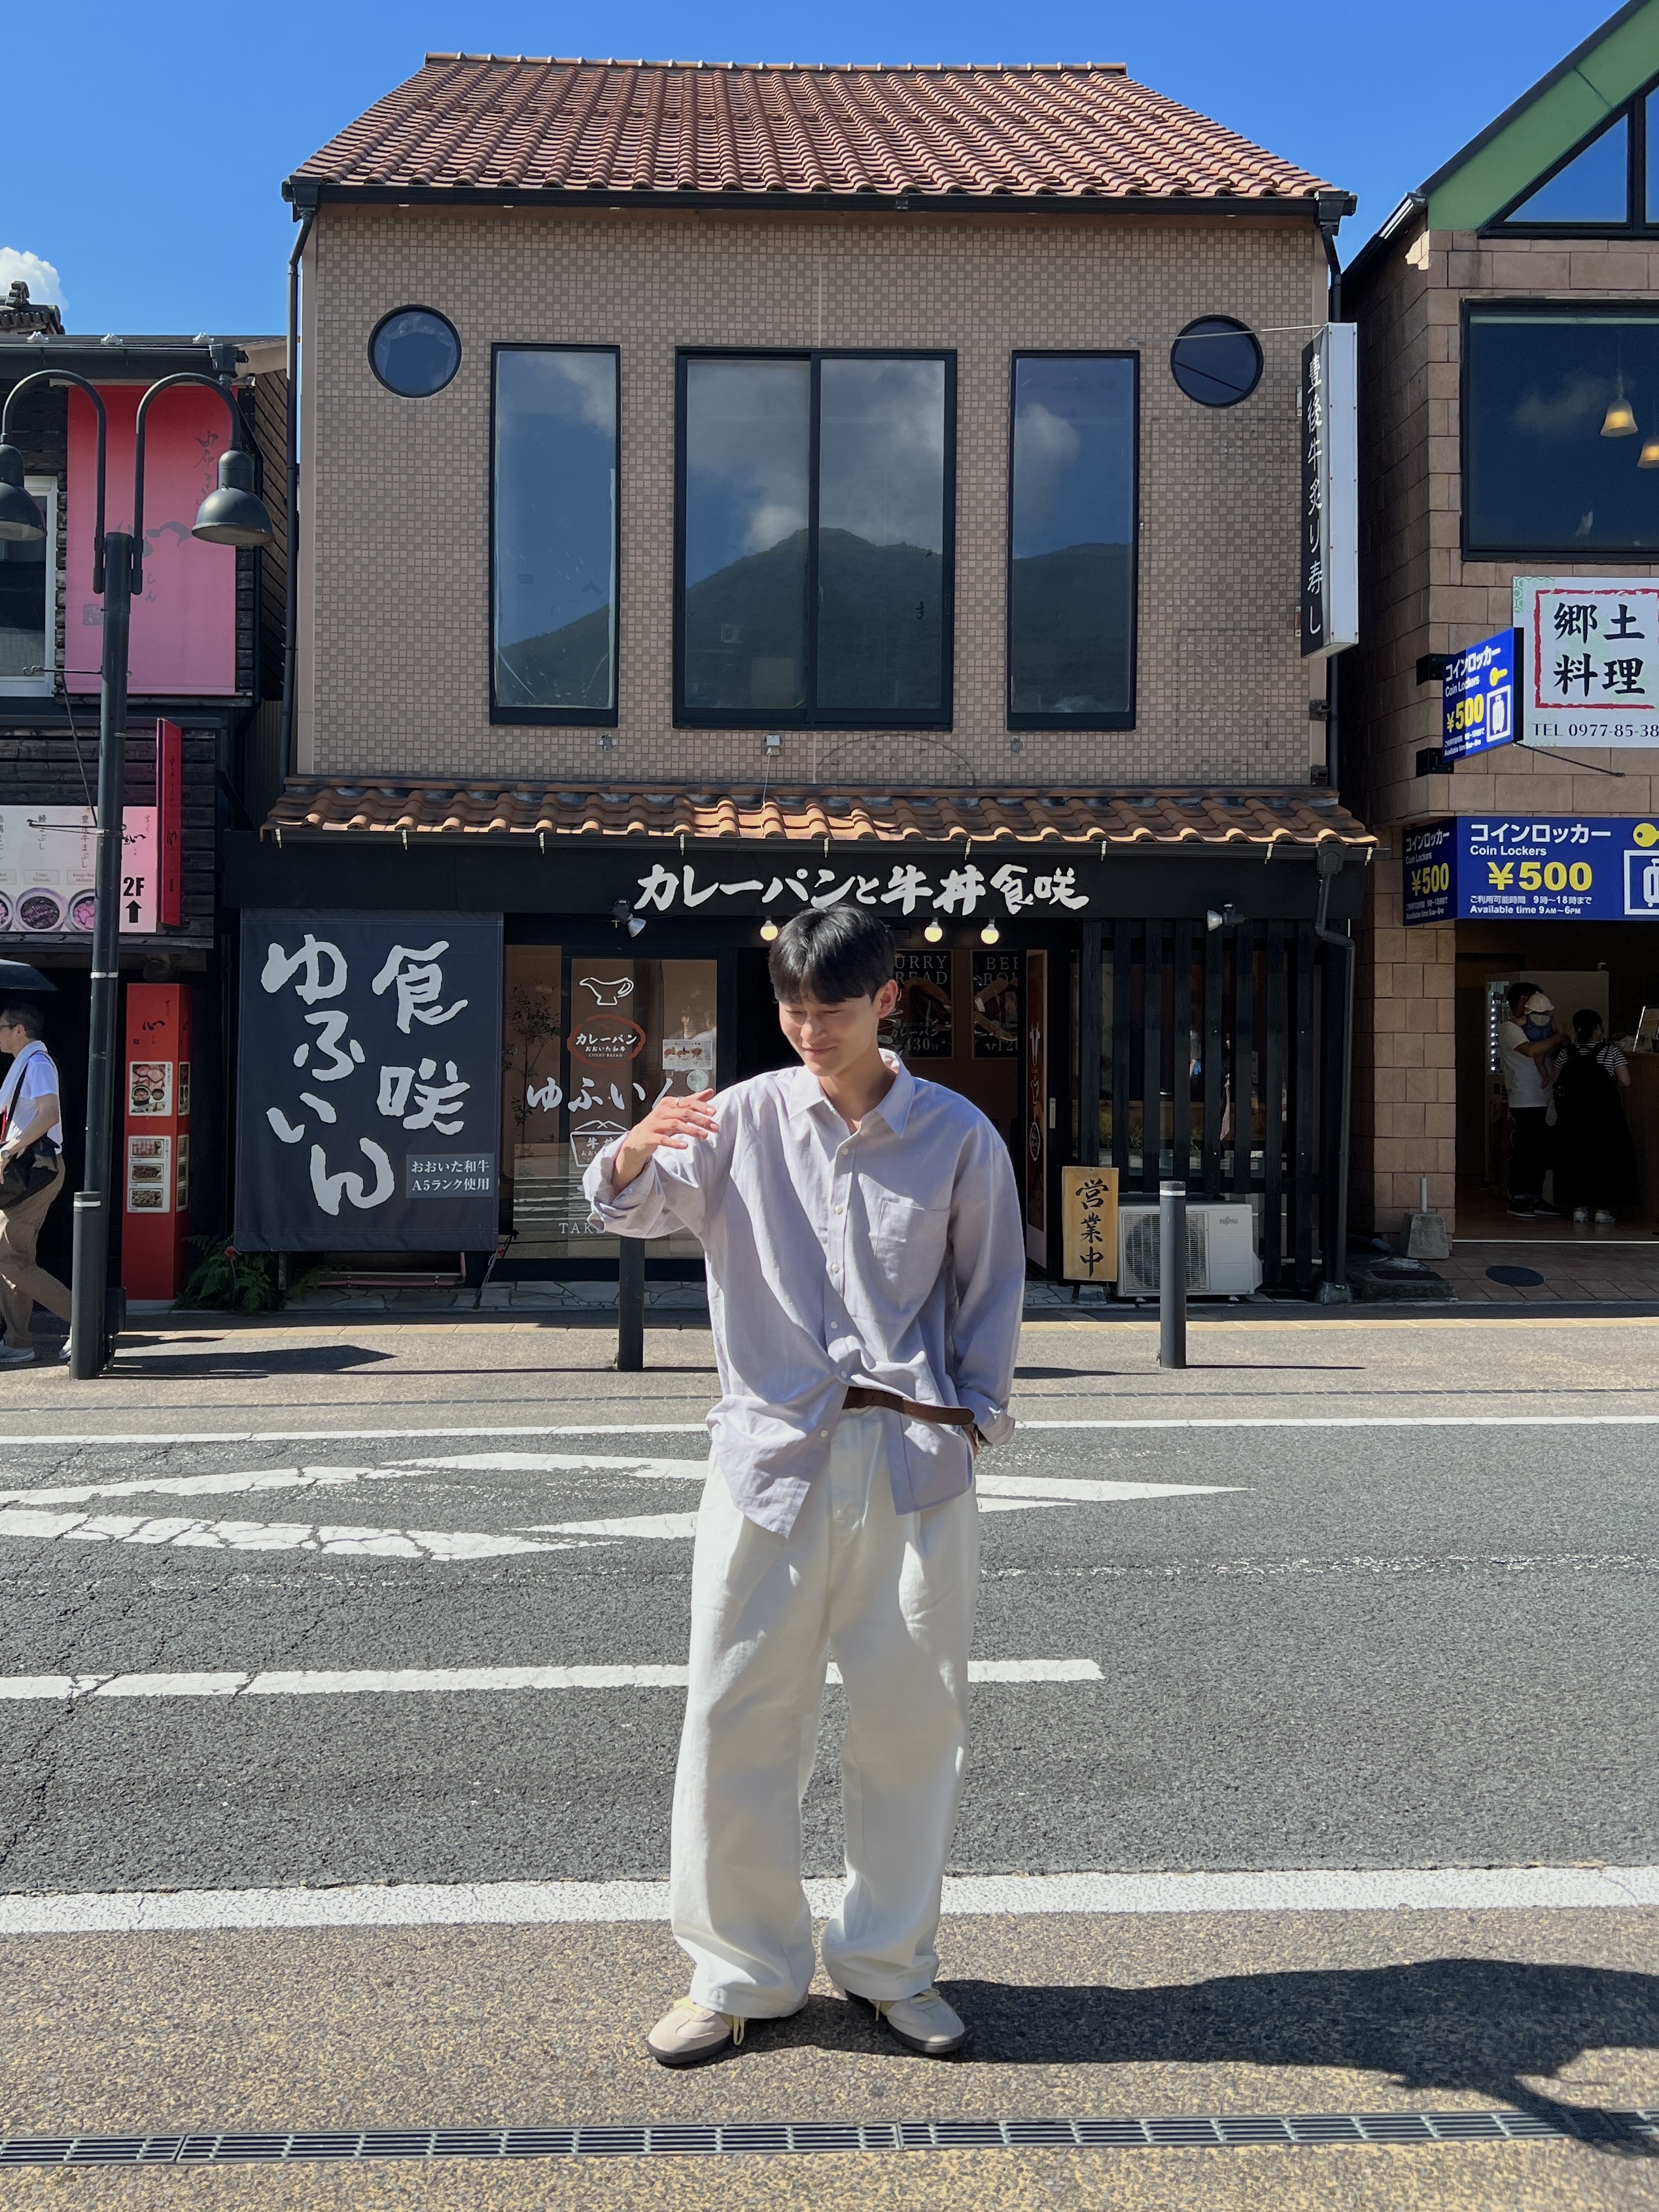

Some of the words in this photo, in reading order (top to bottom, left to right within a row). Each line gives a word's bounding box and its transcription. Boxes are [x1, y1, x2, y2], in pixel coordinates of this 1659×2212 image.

[1553, 602, 1645, 644] 郷土
[1445, 645, 1501, 682] コインロッカー
[1552, 653, 1646, 697] 料理
[1445, 684, 1458, 697] Coin
[1446, 693, 1484, 733] ¥500
[1531, 723, 1563, 737] TEL
[1406, 828, 1450, 852] コインロッカー
[1471, 823, 1611, 844] コインロッカー
[1406, 855, 1416, 865] Coin
[1416, 852, 1432, 862] Lockers
[1470, 845, 1497, 856] Coin
[1501, 845, 1547, 856] Lockers
[123, 877, 145, 897] 2F
[1411, 862, 1450, 896] ¥500
[1487, 862, 1593, 892] ¥500
[1516, 905, 1537, 914] time
[575, 1032, 637, 1047] カレーパン
[260, 934, 395, 1216] ゆふいん
[411, 1159, 490, 1174] おおいた和牛
[411, 1178, 490, 1192] A5ランク使用
[559, 1222, 606, 1235] TAK
[1075, 1178, 1109, 1278] 営業中
